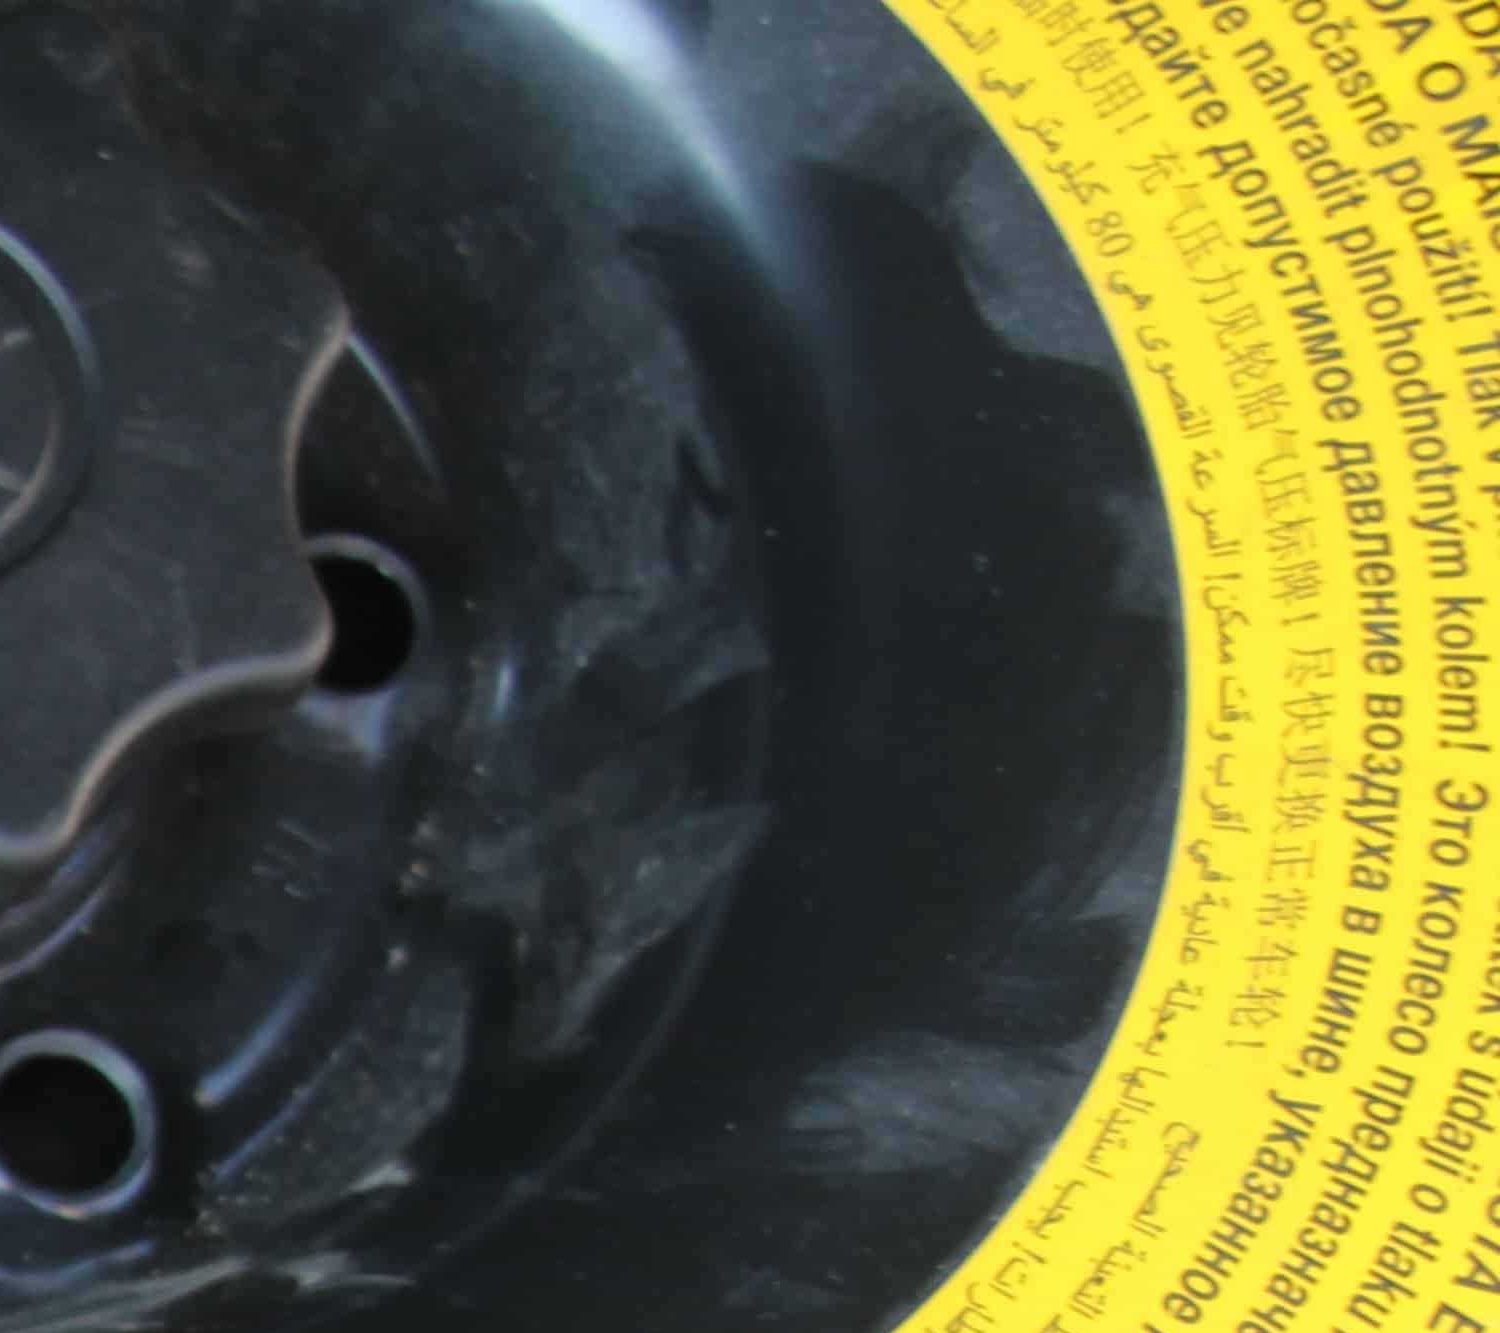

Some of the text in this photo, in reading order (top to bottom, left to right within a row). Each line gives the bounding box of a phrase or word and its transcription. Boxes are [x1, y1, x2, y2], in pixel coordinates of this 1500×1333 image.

[1104, 0, 1232, 130] дайте
[1083, 209, 1136, 260] 80
[1196, 137, 1364, 427] допустимое
[1369, 155, 1496, 323] použití!
[1234, 36, 1494, 756] nahradit plnohodnotným kolem!
[1314, 436, 1404, 677] давление
[1341, 690, 1405, 894] воздуха
[1426, 776, 1492, 869] Это
[1341, 905, 1384, 937] в
[1386, 879, 1466, 1057] колесо
[1281, 945, 1374, 1080] шине,
[1161, 1087, 1323, 1325] указанное
[1407, 1181, 1451, 1216] o
[1344, 1219, 1444, 1332] tlaku
